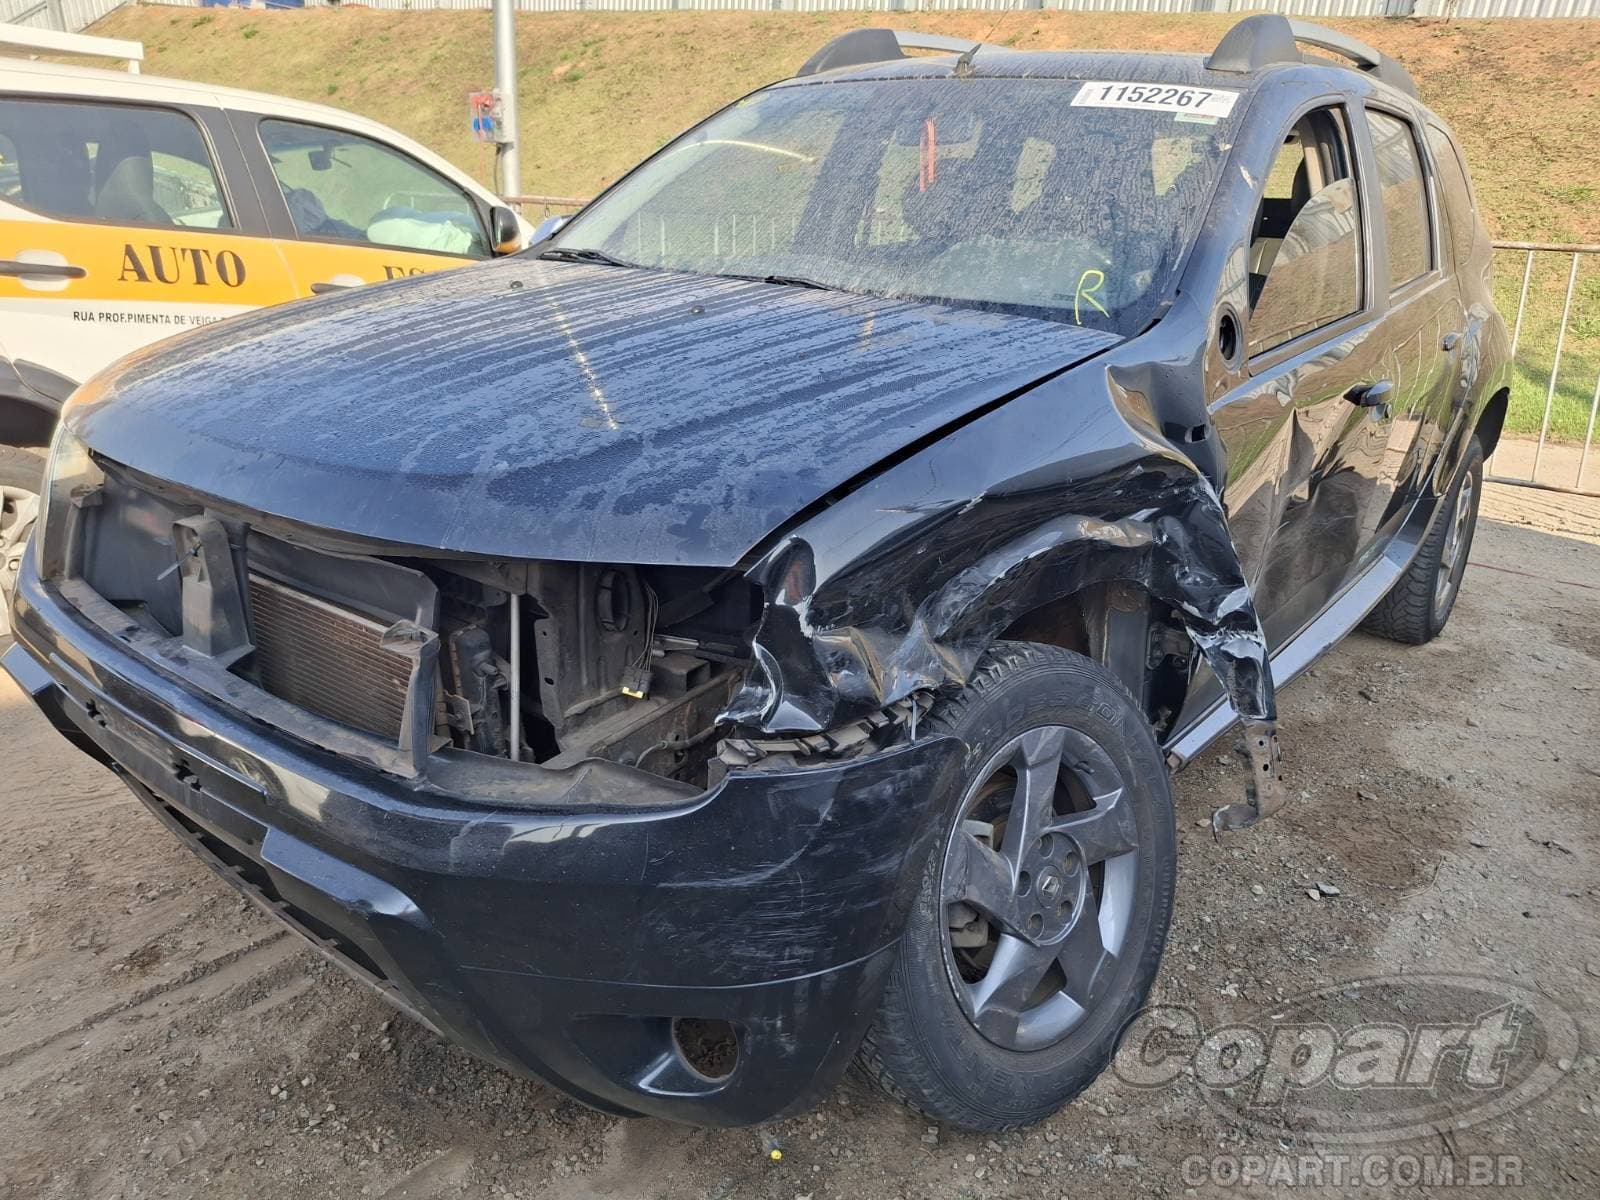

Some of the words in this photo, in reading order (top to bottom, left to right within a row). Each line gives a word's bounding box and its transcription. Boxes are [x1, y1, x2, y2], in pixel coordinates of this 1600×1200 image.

[1100, 85, 1213, 108] 1152267
[117, 243, 247, 288] AUTO
[1074, 269, 1110, 325] R
[73, 311, 95, 322] RUA
[98, 312, 171, 324] PROF.PIMENTA
[174, 315, 186, 325] DE
